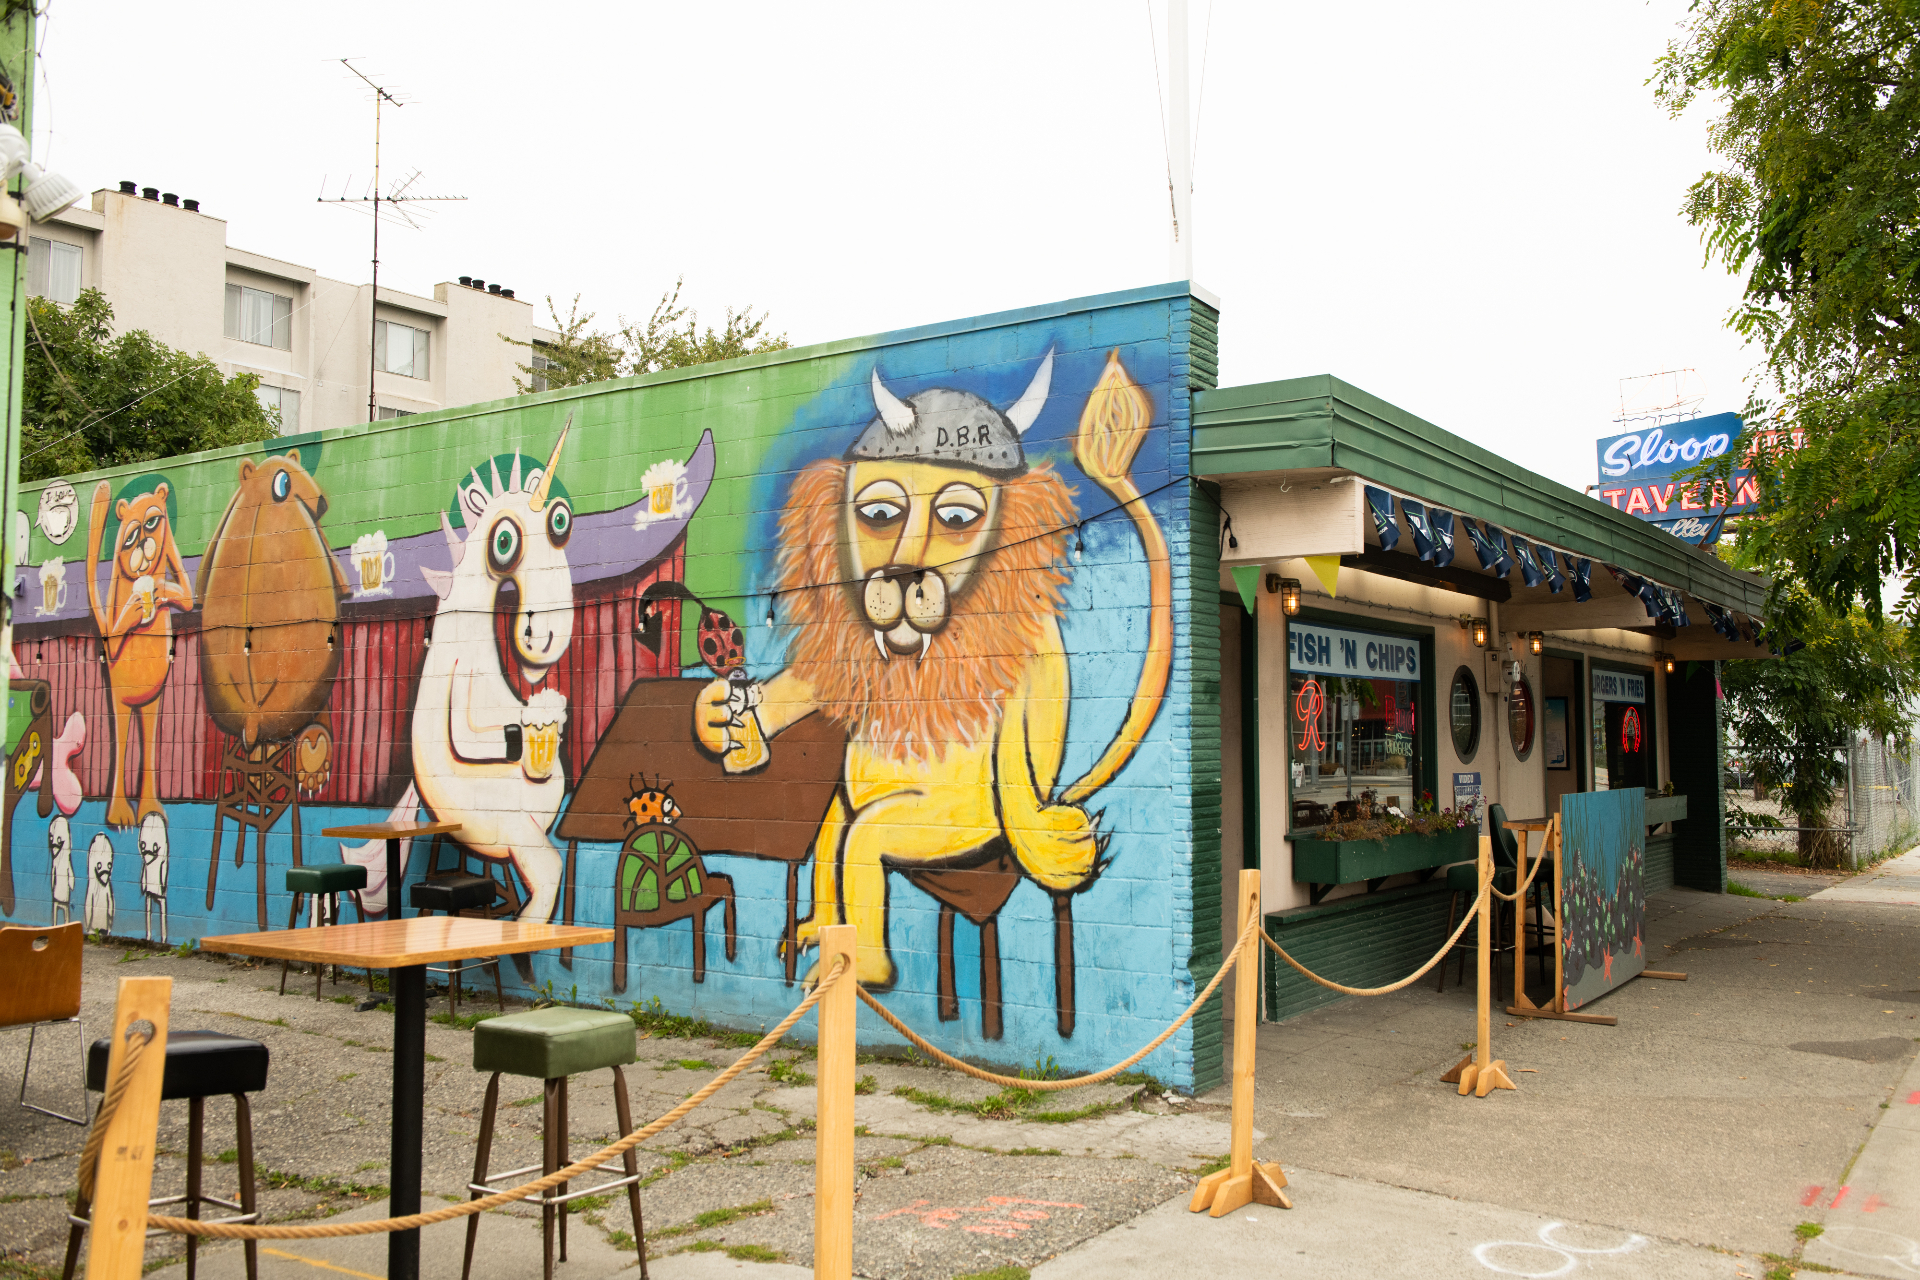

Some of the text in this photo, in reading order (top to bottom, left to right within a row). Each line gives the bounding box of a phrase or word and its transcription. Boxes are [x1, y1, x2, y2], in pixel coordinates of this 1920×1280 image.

[1602, 428, 1730, 476] Sloop
[1603, 475, 1761, 516] TAVERN
[1366, 641, 1416, 674] CHIPS
[1627, 678, 1644, 699] FRIES
[1385, 738, 1413, 757] BURGERS
[1458, 774, 1474, 784] VIDEO
